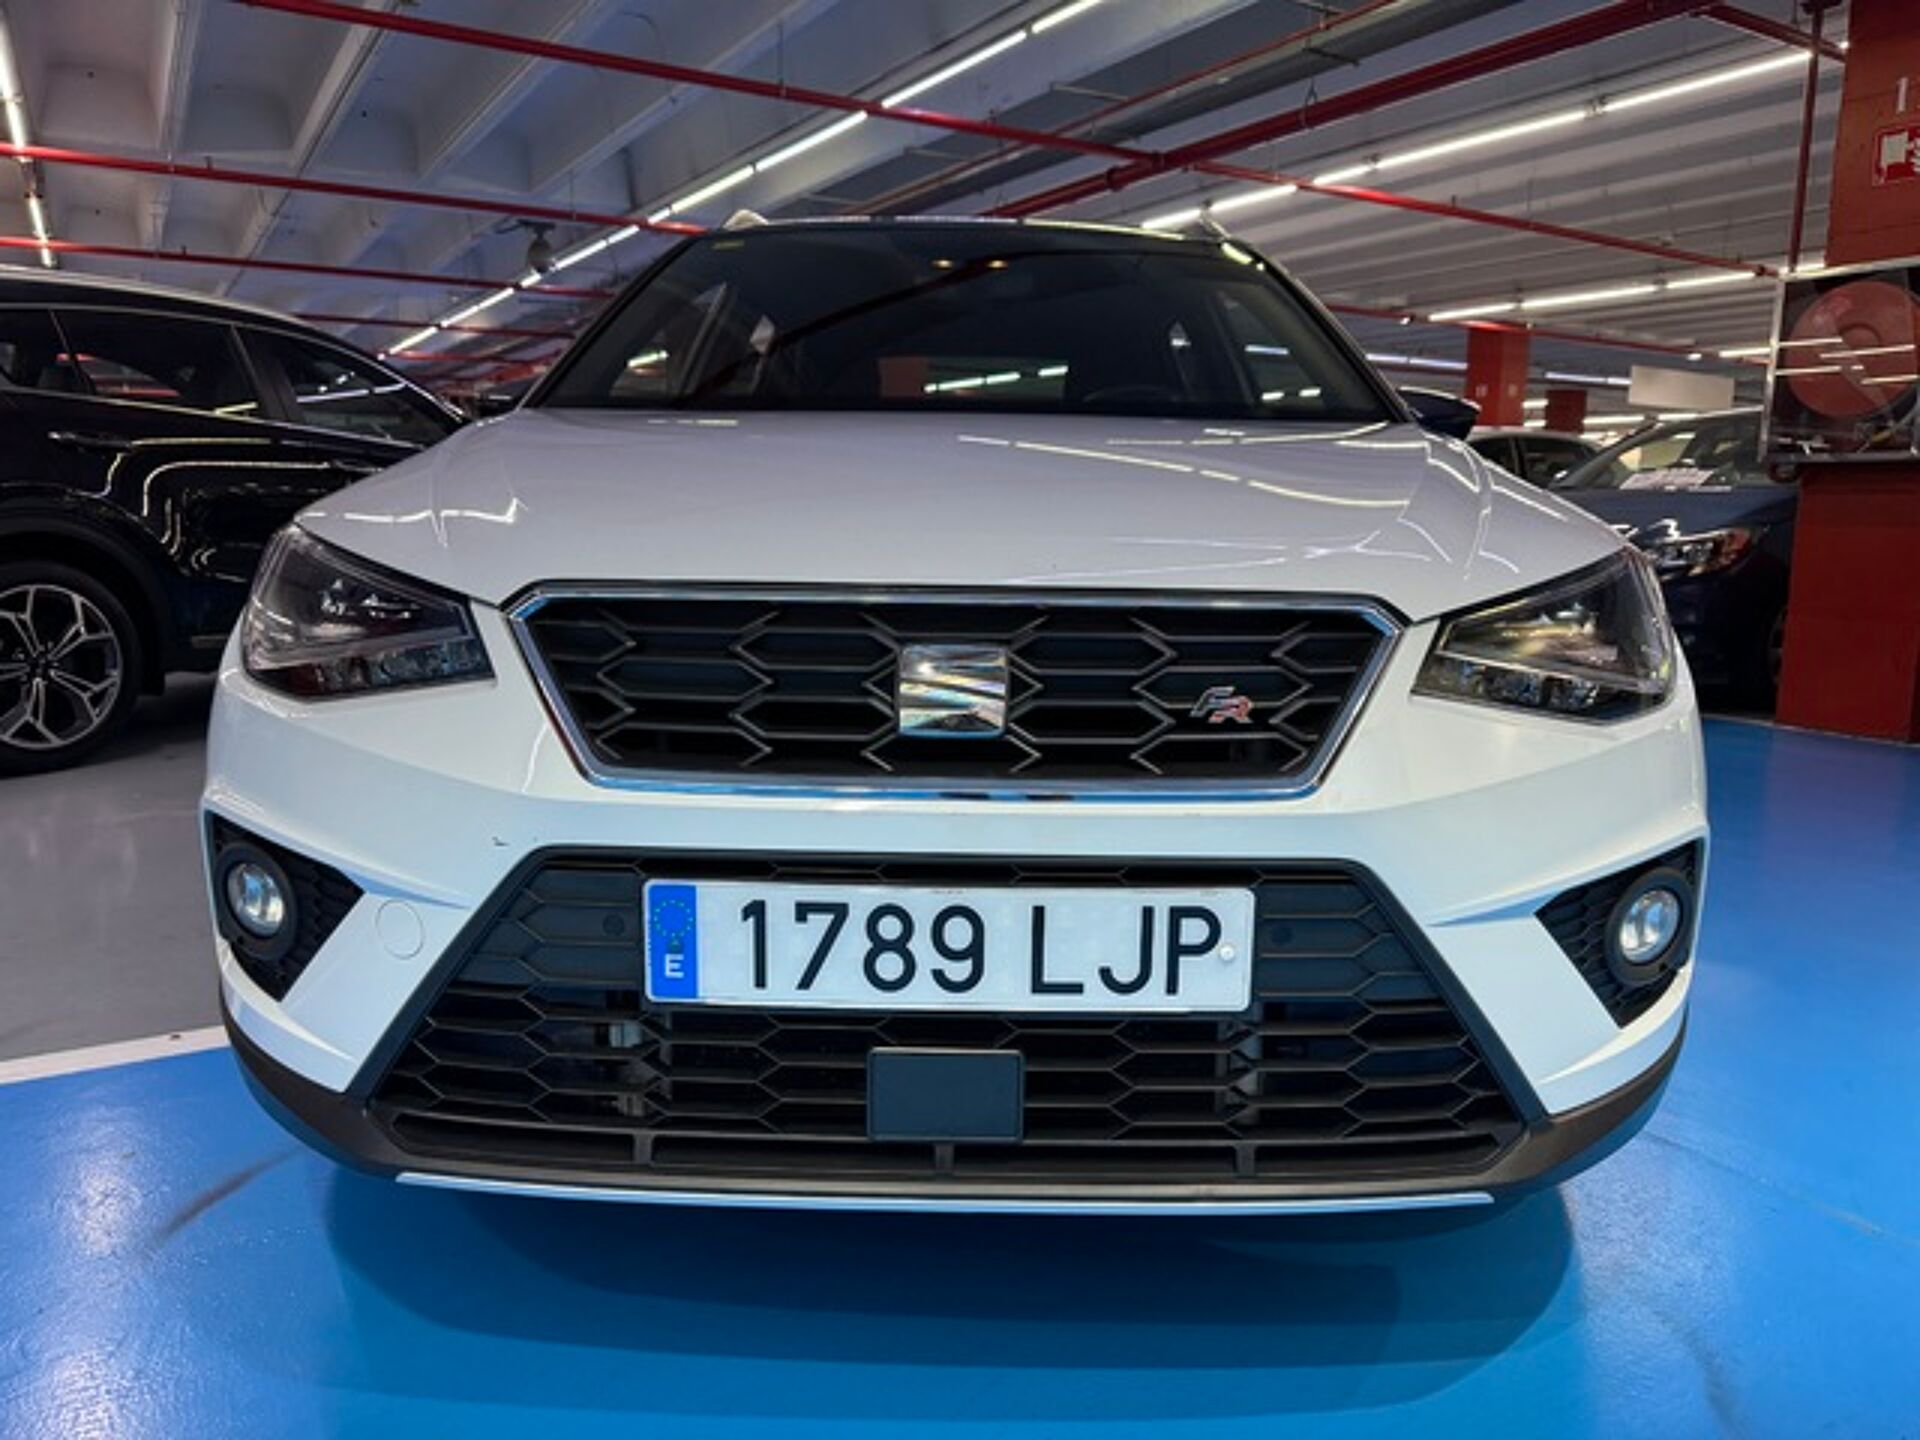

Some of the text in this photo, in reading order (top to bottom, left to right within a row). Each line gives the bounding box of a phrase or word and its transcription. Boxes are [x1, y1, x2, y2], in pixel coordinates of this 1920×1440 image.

[1190, 686, 1253, 724] FR
[664, 953, 685, 978] E
[741, 899, 1222, 996] 1789 LJP
